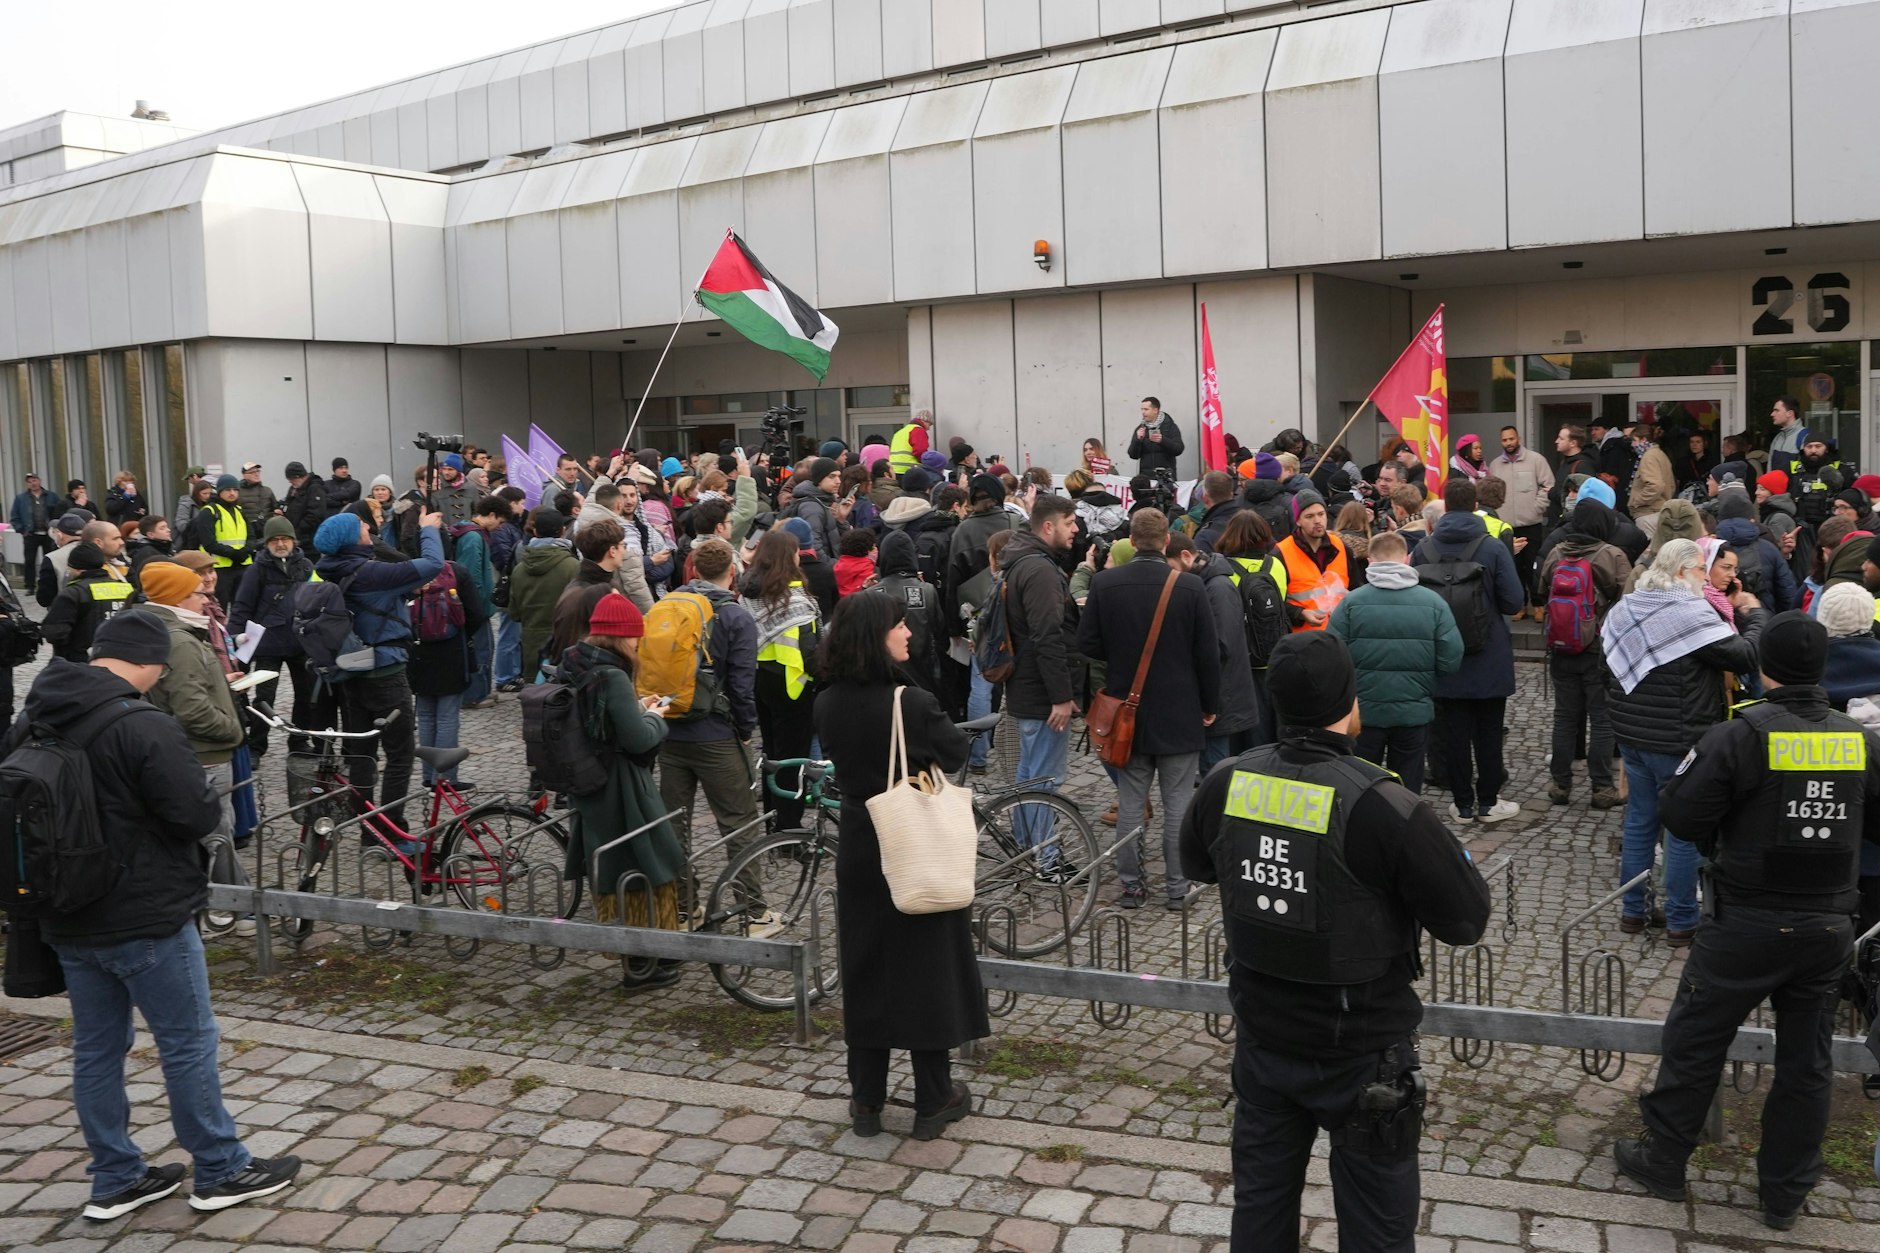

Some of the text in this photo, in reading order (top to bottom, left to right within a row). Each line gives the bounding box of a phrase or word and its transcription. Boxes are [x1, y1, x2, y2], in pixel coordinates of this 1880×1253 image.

[1752, 272, 1850, 336] 26
[1774, 737, 1862, 765] POLIZEI
[1229, 775, 1330, 830] POLIZEI
[1806, 780, 1835, 799] BE
[1786, 800, 1847, 820] 16321
[1259, 835, 1290, 864] BE
[1241, 858, 1308, 894] 16331
